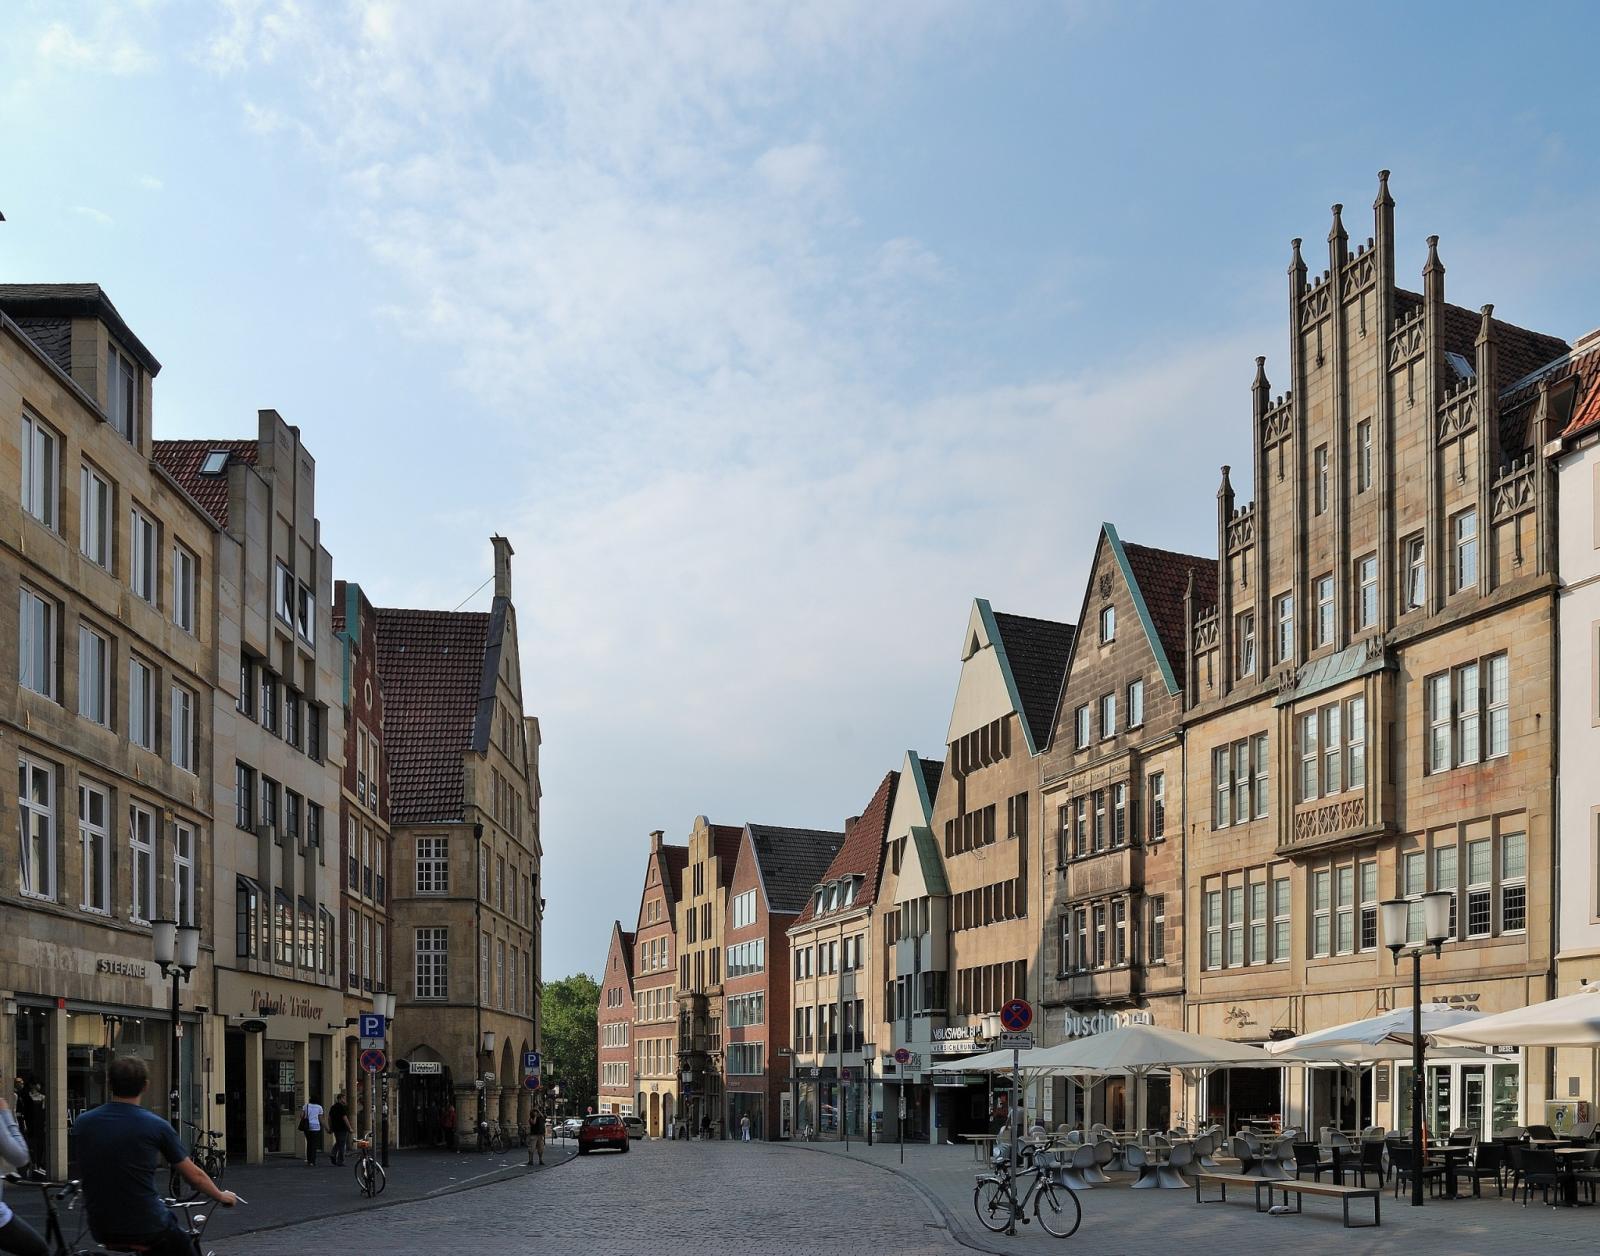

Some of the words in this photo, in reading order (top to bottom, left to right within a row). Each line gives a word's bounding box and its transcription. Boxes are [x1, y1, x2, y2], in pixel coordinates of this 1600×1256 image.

[290, 995, 323, 1020] Träber
[365, 1017, 379, 1035] P
[933, 1026, 969, 1040] VOLKSWOHL
[527, 1054, 536, 1066] P
